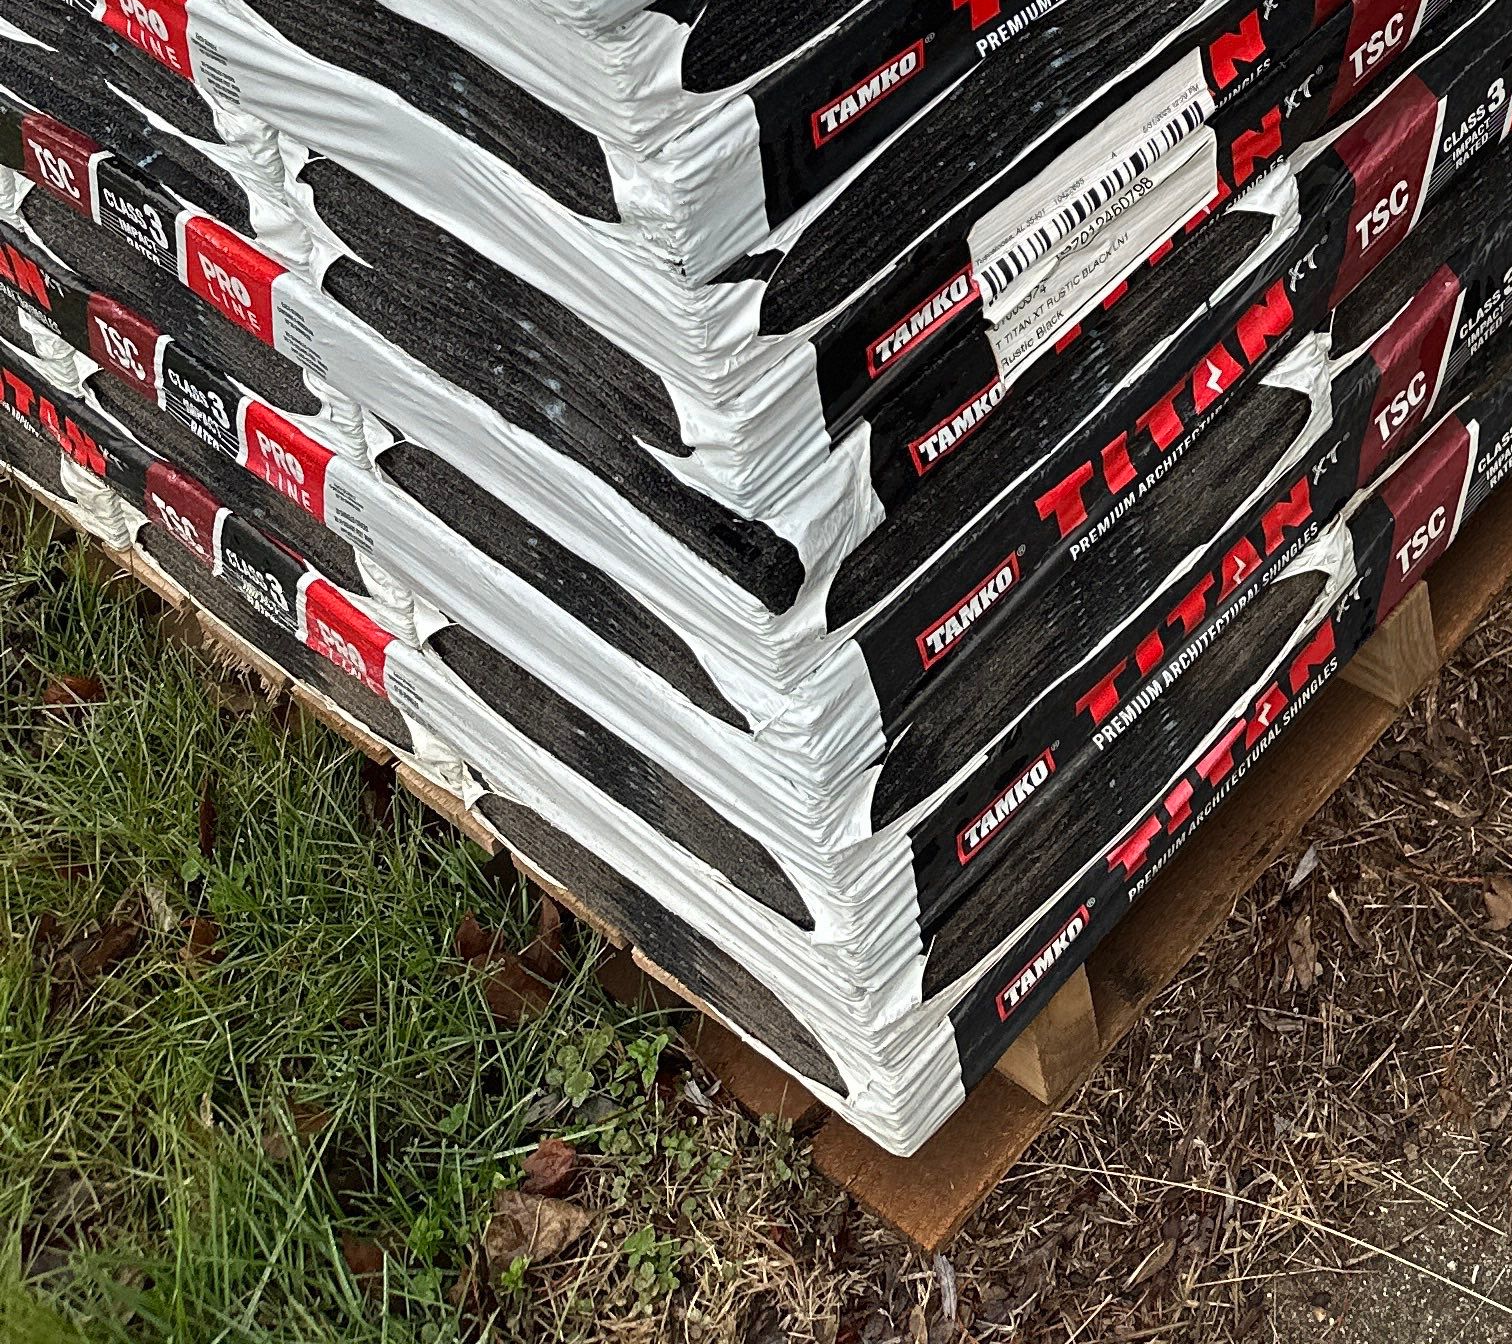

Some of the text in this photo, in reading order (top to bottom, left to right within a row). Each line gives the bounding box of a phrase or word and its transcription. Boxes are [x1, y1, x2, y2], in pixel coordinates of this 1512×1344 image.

[126, 22, 181, 71] LINE
[1349, 12, 1404, 79] TSC
[29, 140, 78, 198] TSC
[103, 188, 168, 249] CLASS 3
[1356, 180, 1409, 250] TSC
[199, 251, 252, 307] PRO
[208, 287, 261, 333] LINE
[1005, 317, 1032, 346] TITAN
[1046, 273, 1083, 307] RUSTIC
[95, 316, 146, 381] TSC
[875, 275, 969, 362] TAMKO
[1000, 311, 1064, 371] Rustic Black
[1034, 279, 1294, 538] TITAN
[1375, 370, 1427, 441] TSC
[257, 430, 304, 484] PRO
[264, 465, 312, 513] LINE
[1397, 506, 1446, 575] TSC
[925, 566, 1013, 653] TAMKO
[1075, 476, 1313, 725] TITAN
[1106, 617, 1336, 881] TITAN
[1128, 657, 1339, 902] PREMIUM ARCHITECTURAL SHINGLES
[963, 761, 1049, 848] TAMKO
[1003, 917, 1084, 1006] TAMKO
